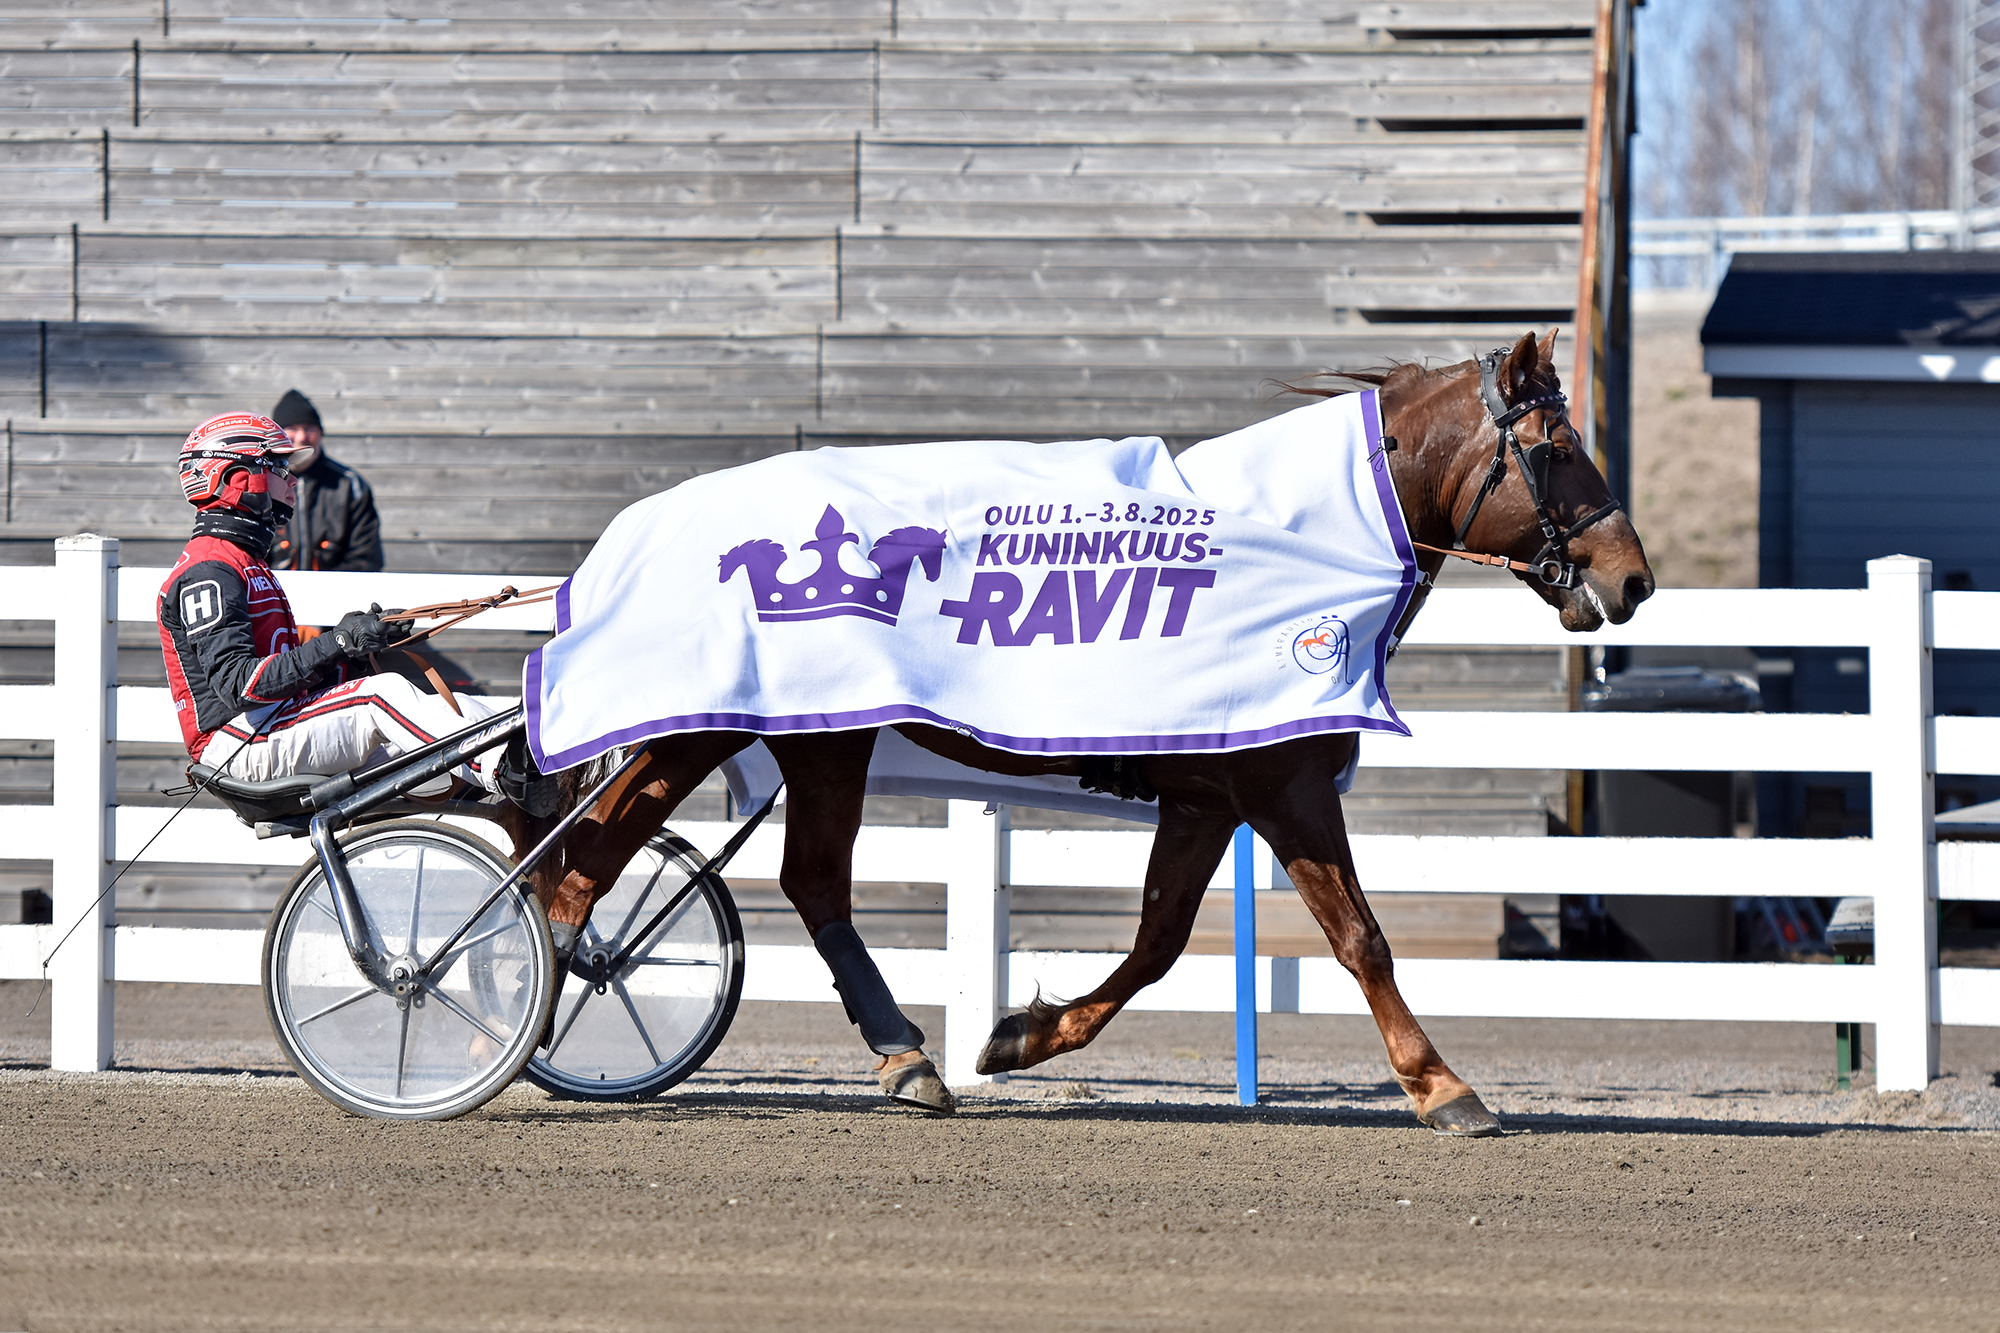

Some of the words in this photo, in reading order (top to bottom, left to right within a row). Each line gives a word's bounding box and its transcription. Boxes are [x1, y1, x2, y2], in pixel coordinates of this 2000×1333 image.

[208, 419, 249, 431] HEIKKINEN
[213, 451, 242, 460] FINNTACK
[985, 504, 1054, 526] OULU
[976, 530, 1223, 566] KUNINKUUS-
